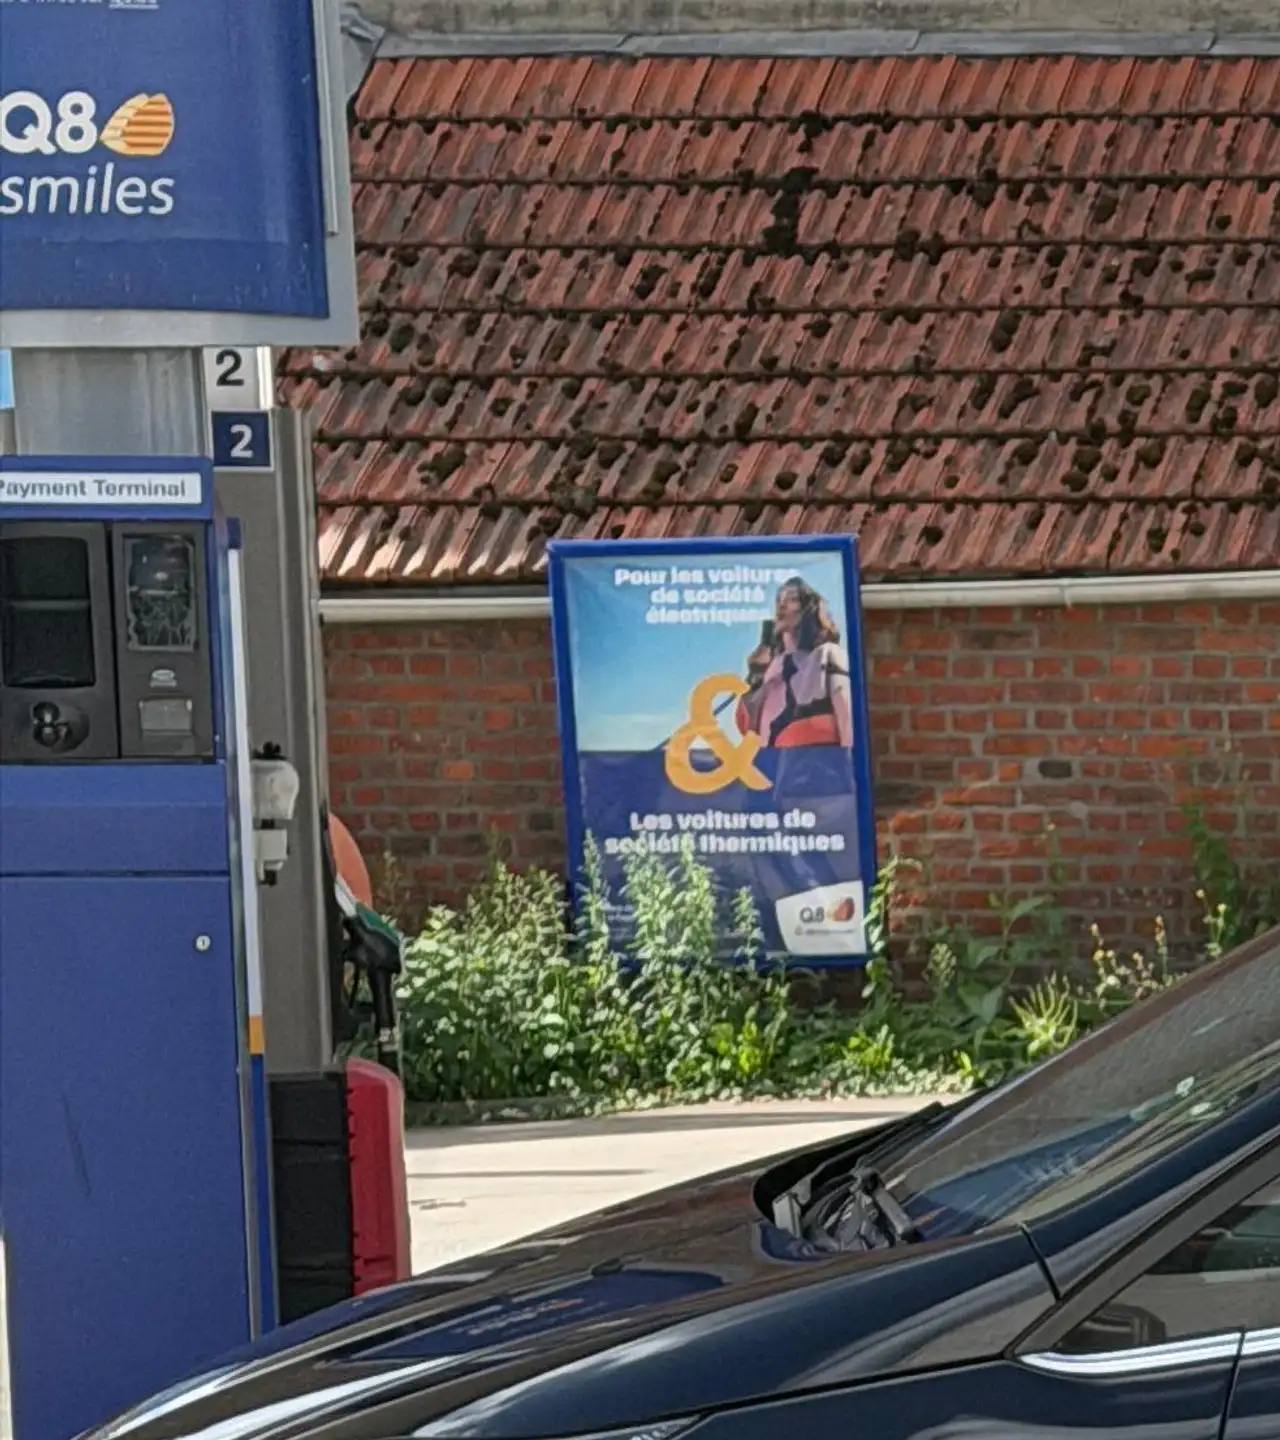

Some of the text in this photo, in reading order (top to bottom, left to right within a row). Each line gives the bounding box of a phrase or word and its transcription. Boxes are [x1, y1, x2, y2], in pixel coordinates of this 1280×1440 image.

[0, 91, 97, 154] Q8
[0, 163, 174, 214] smiles
[216, 349, 244, 387] 2
[230, 424, 253, 458] 2
[93, 479, 186, 497] Terminal
[614, 568, 664, 586] Pour
[671, 566, 703, 584] les
[651, 585, 765, 604] de société
[630, 808, 816, 831] Les voitures de
[700, 832, 845, 856] thermiques
